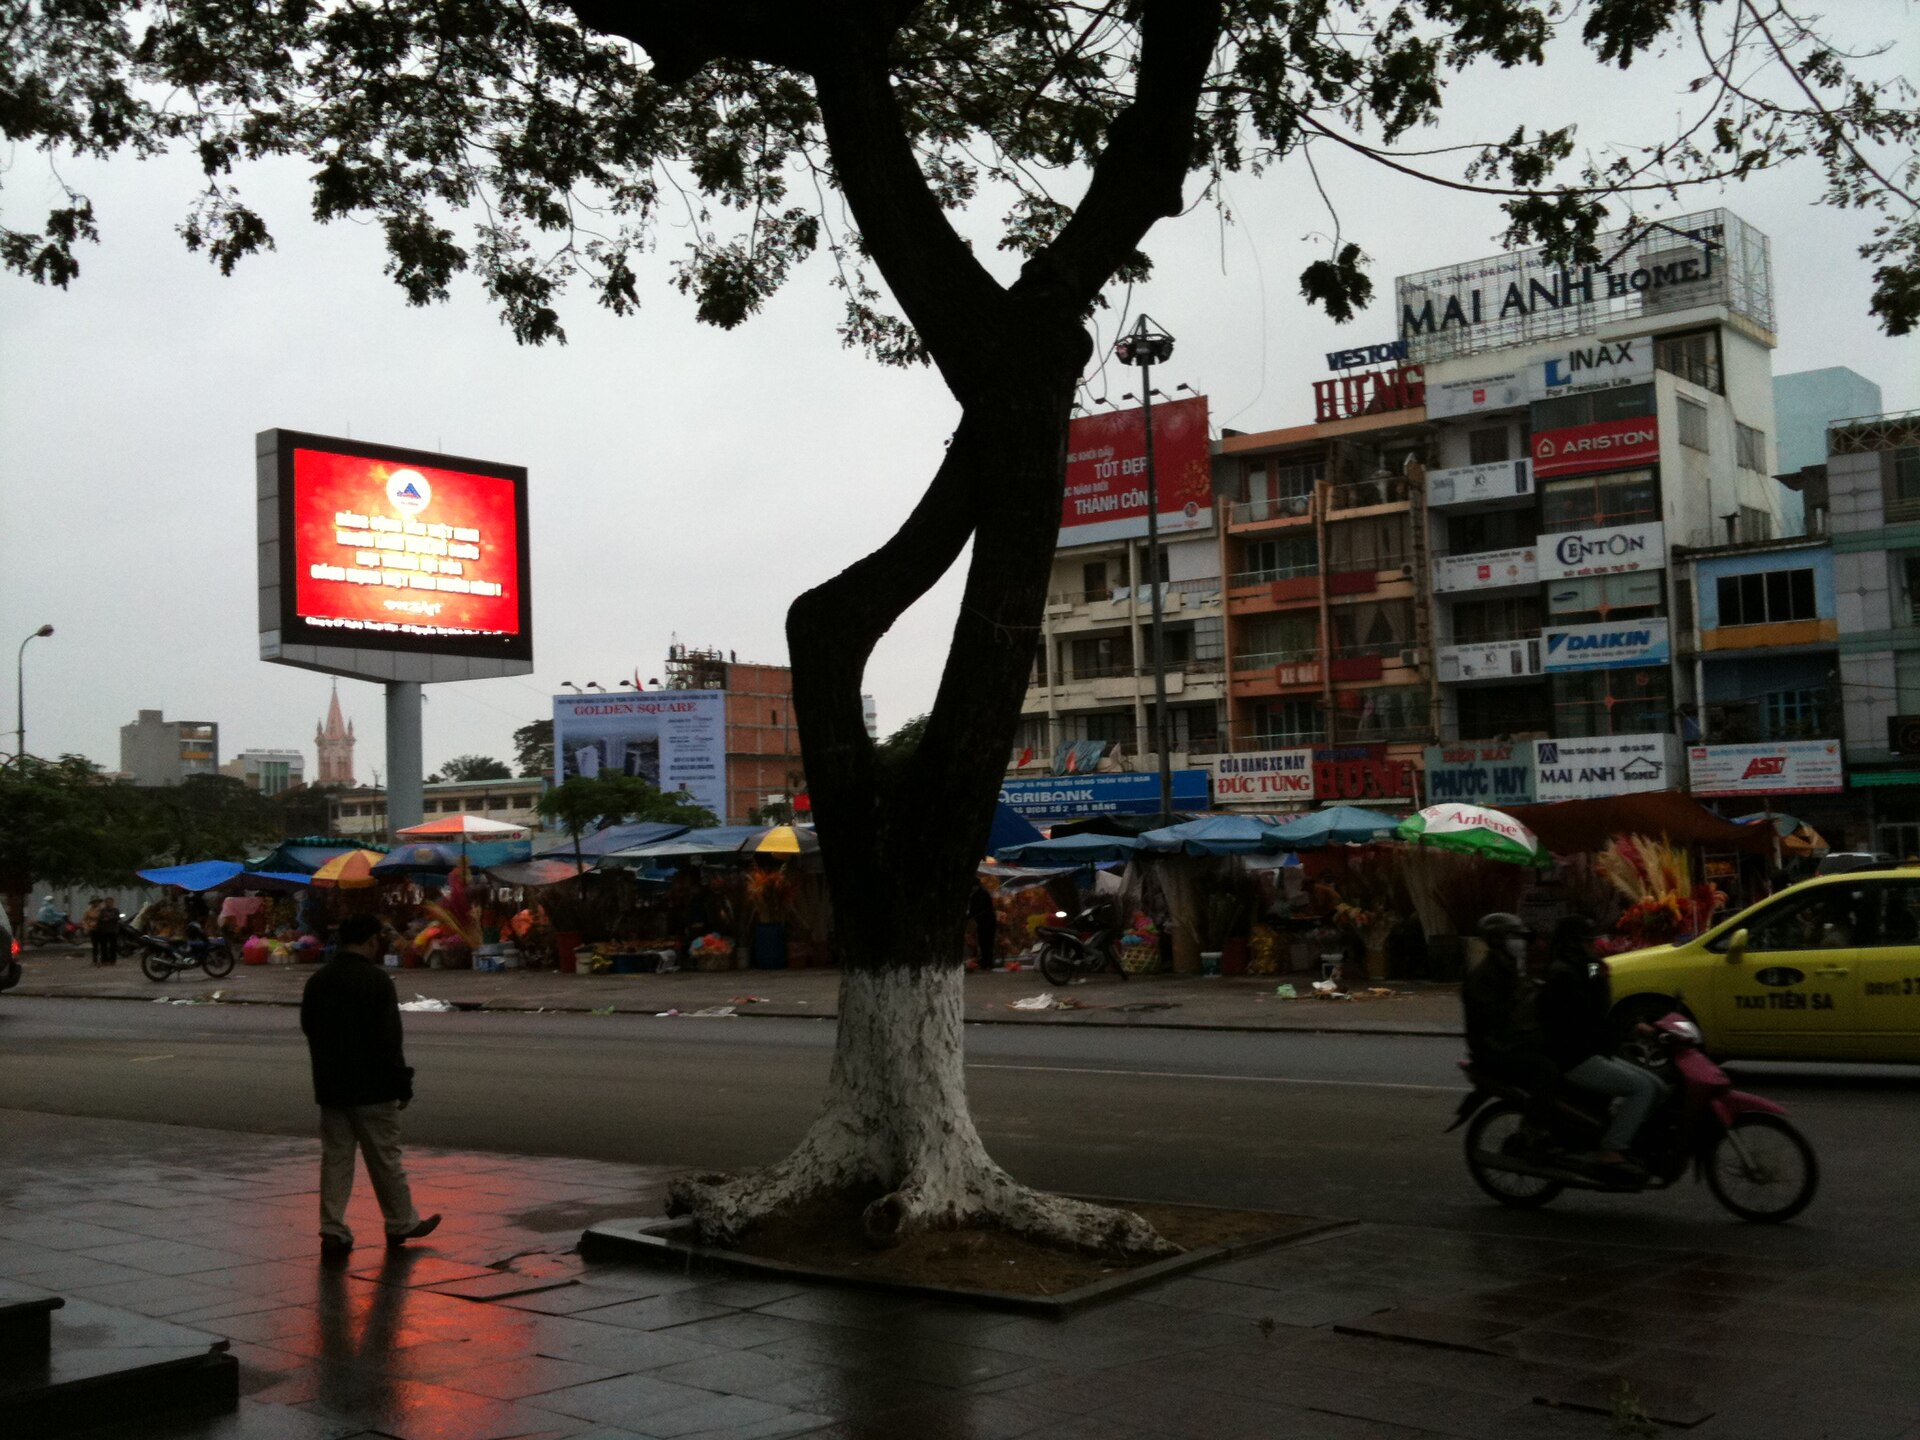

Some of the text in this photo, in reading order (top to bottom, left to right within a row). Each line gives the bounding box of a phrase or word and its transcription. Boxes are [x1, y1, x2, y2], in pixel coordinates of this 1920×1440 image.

[1402, 290, 1481, 340] MAI
[1500, 267, 1593, 318] ANH
[1607, 258, 1701, 297] HOME
[1570, 342, 1634, 372] INAX
[1546, 377, 1632, 398] For Precious Life
[1562, 429, 1653, 454] ARISTON
[1094, 459, 1120, 479] TỐT
[1074, 487, 1158, 515] THÀNH CÔN
[1567, 630, 1650, 651] DAIKIN
[574, 702, 697, 716] GOLDEN SQUARE
[1220, 755, 1240, 773] CỬA
[1241, 754, 1268, 772] HÀNG
[1269, 756, 1283, 771] XE
[1284, 752, 1306, 770] MÁY
[1218, 772, 1310, 794] ĐỨC TÙNG
[1431, 763, 1528, 797] PHƯỚC HUY
[1540, 769, 1573, 783] MAI
[1579, 767, 1615, 782] ANH
[998, 789, 1094, 804] AGRIBANK
[1735, 995, 1765, 1009] TAXI
[1811, 992, 1833, 1010] SA
